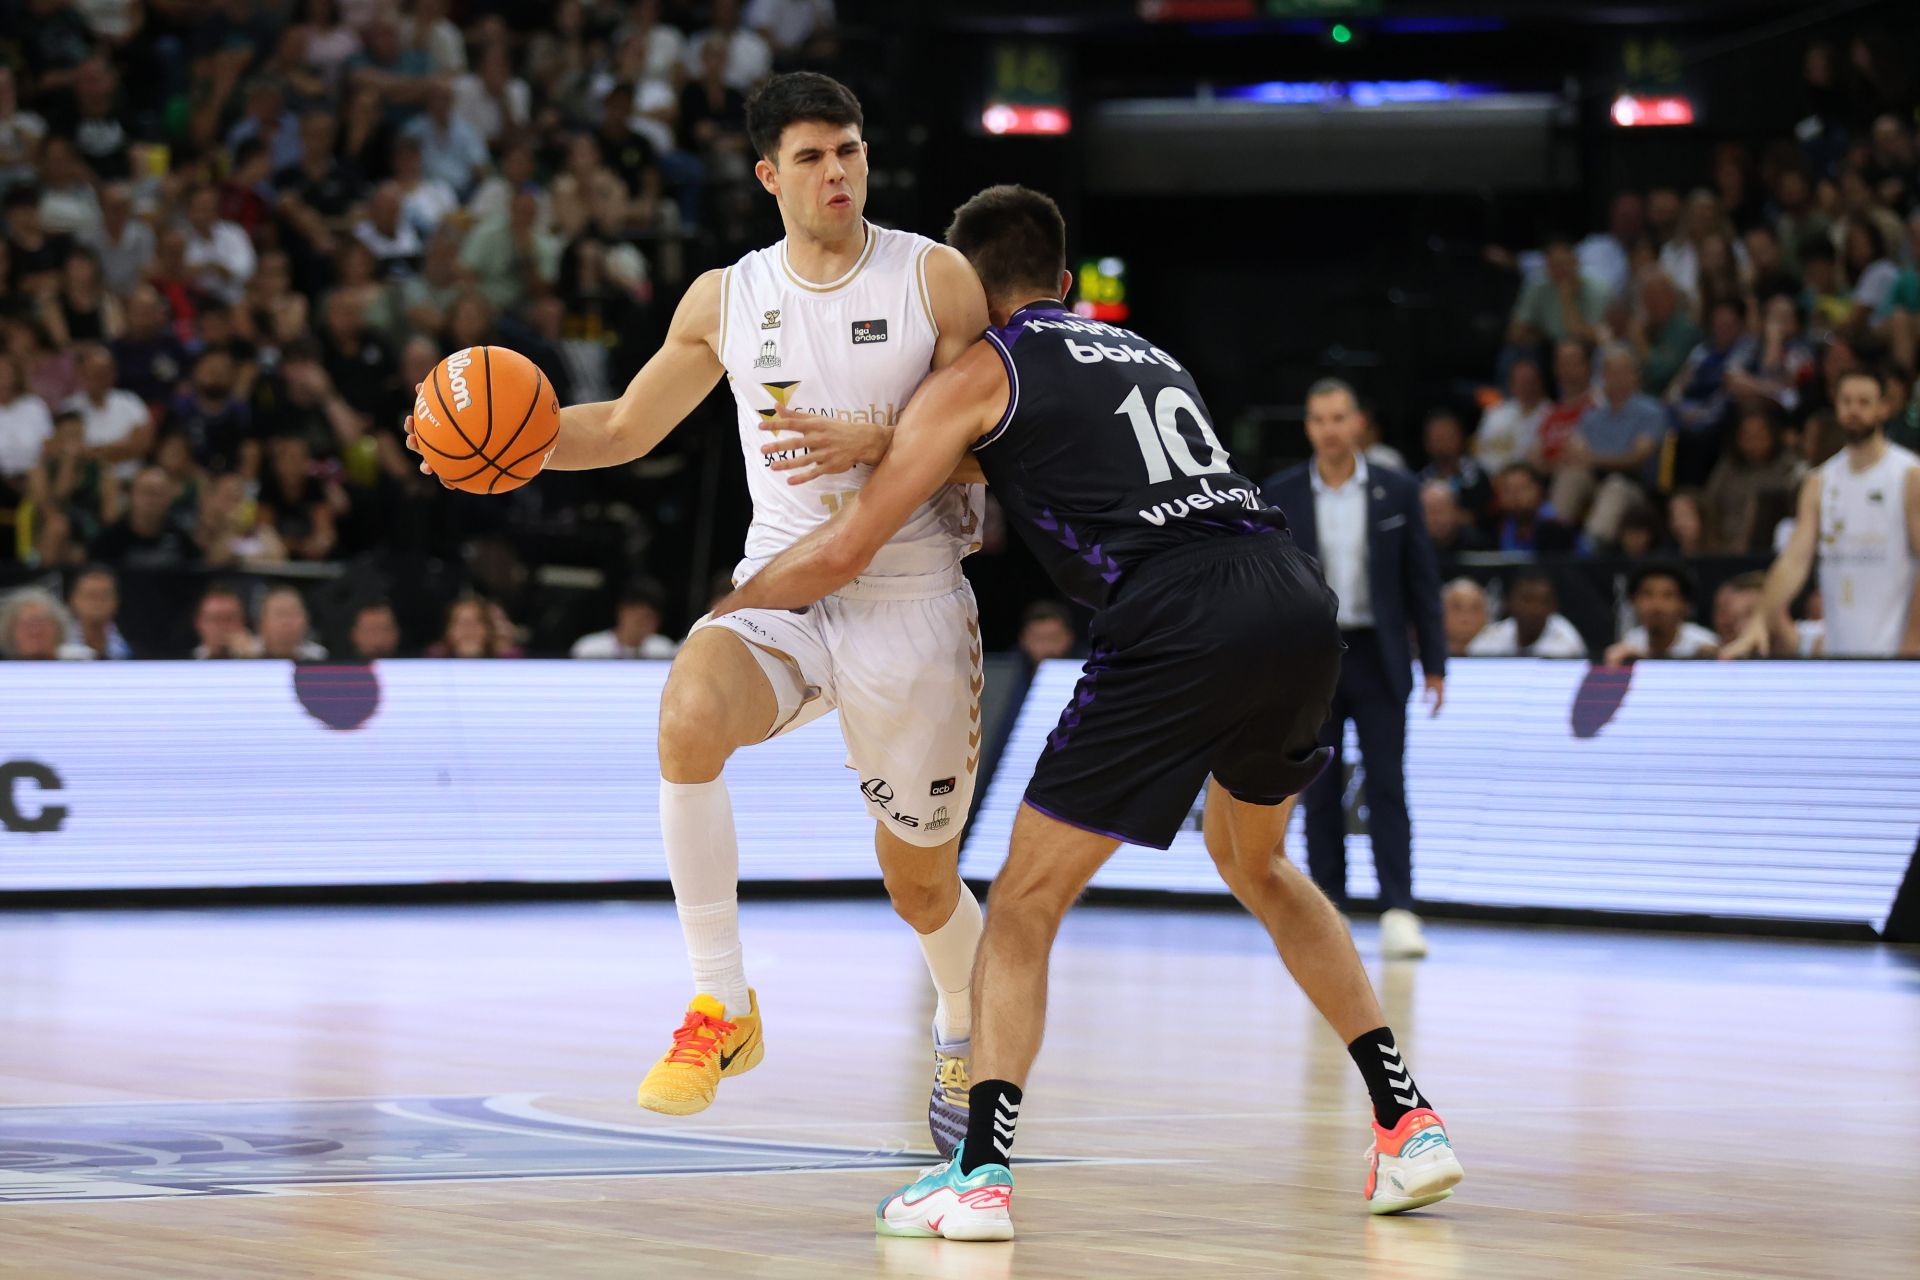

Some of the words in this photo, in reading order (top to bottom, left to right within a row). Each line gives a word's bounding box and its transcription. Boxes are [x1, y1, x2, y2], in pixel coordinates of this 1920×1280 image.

[854, 328, 870, 336] liga
[854, 333, 886, 342] endesa
[447, 347, 473, 413] ilson
[1114, 384, 1231, 485] 10
[932, 785, 950, 795] acb
